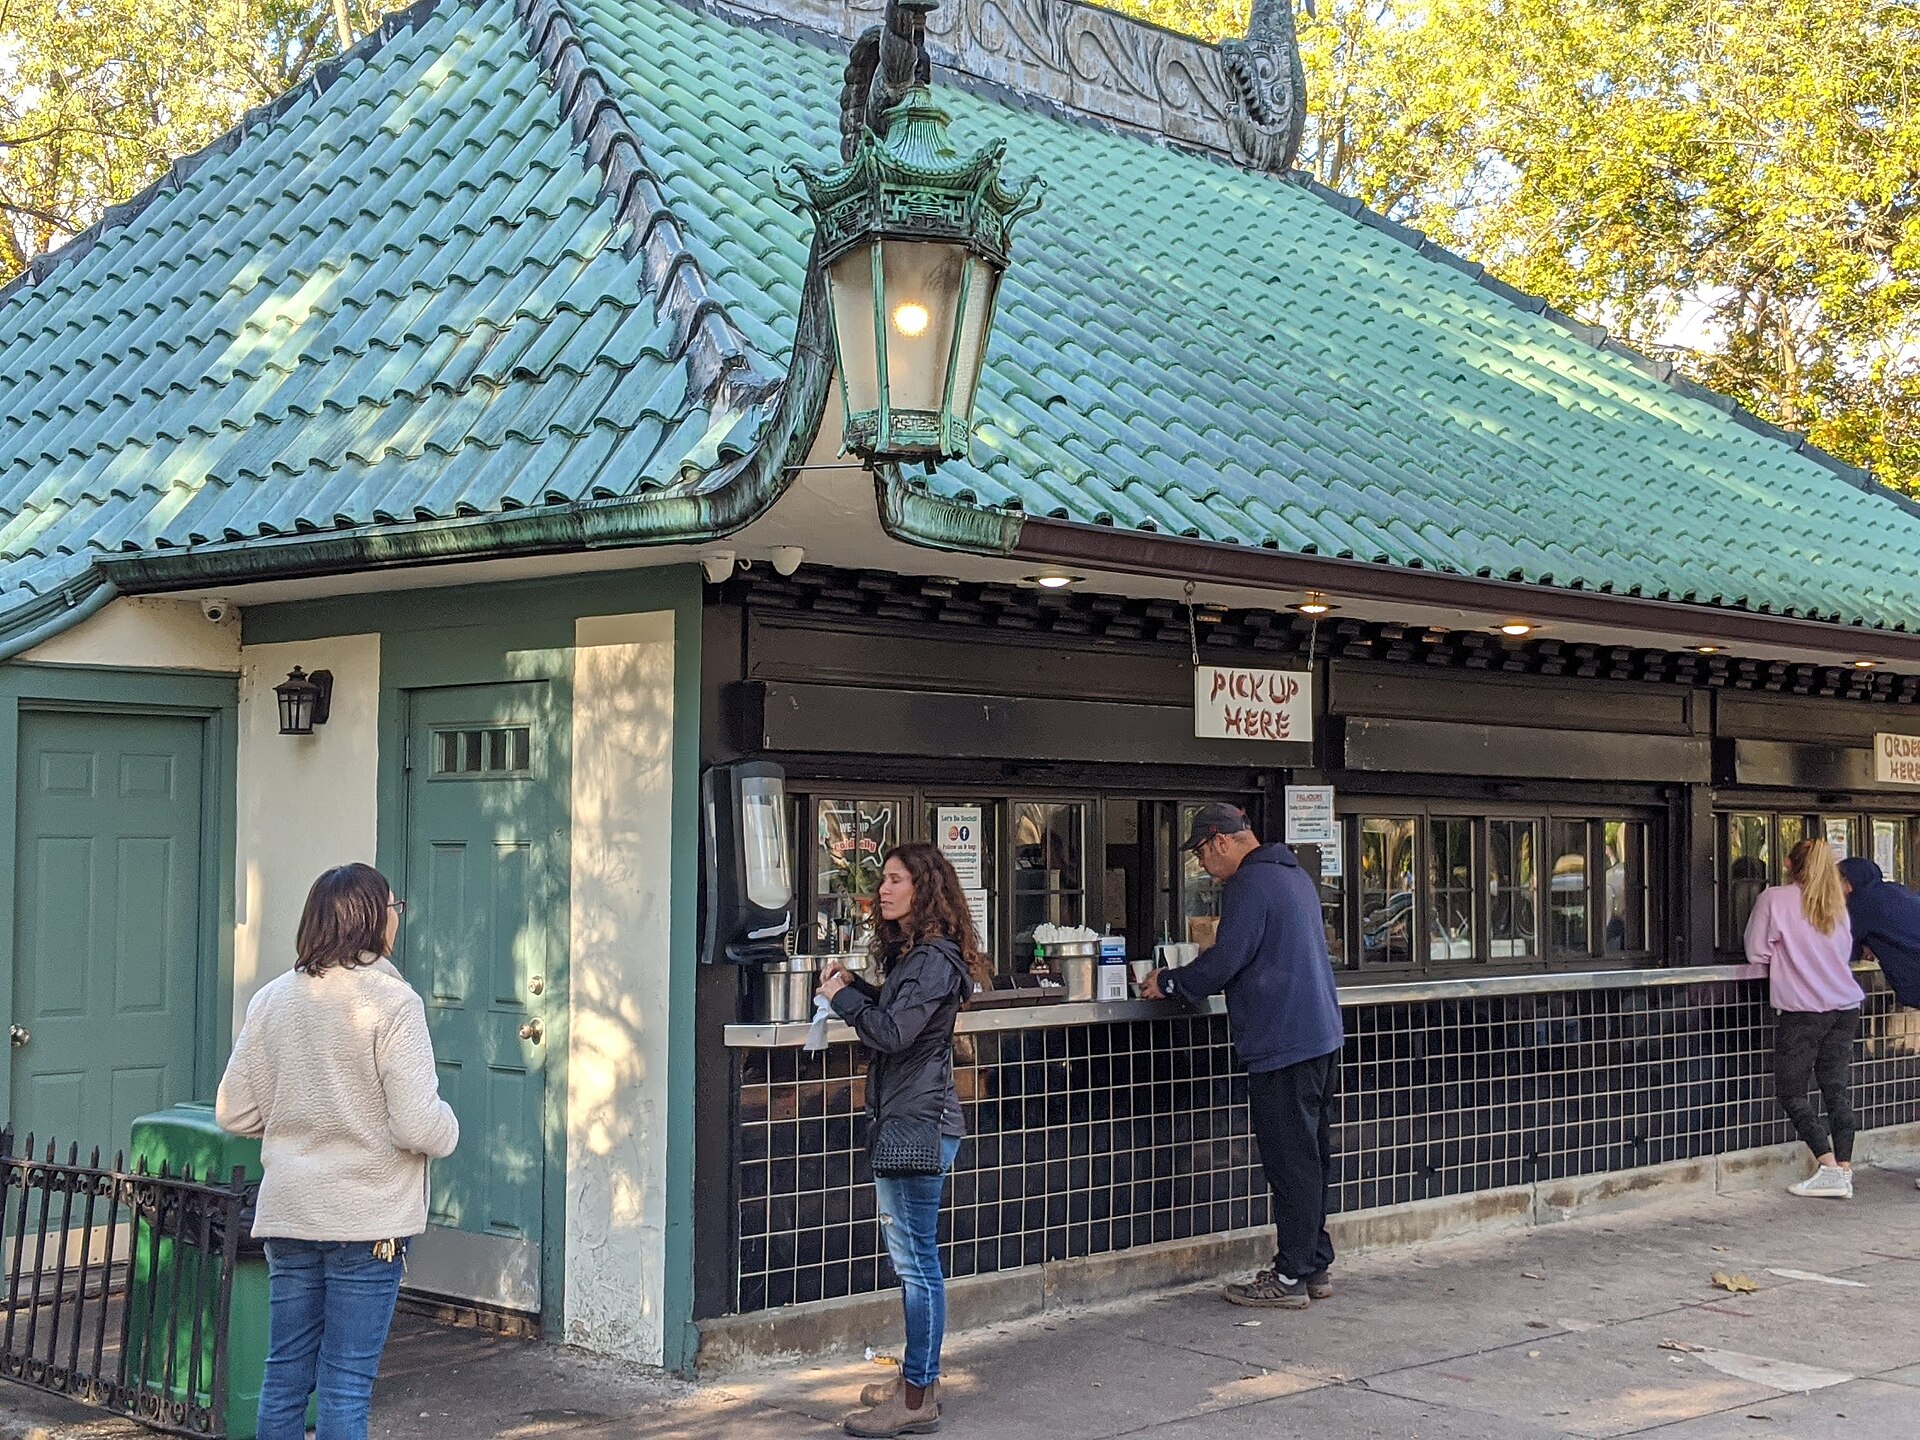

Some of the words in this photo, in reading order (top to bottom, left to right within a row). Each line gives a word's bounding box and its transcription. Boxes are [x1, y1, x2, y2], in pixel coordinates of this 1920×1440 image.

[1210, 669, 1264, 706] PICK
[1269, 673, 1299, 705] UP
[1224, 704, 1291, 740] HERE
[840, 822, 852, 833] WE
[832, 838, 877, 854] goldelly
